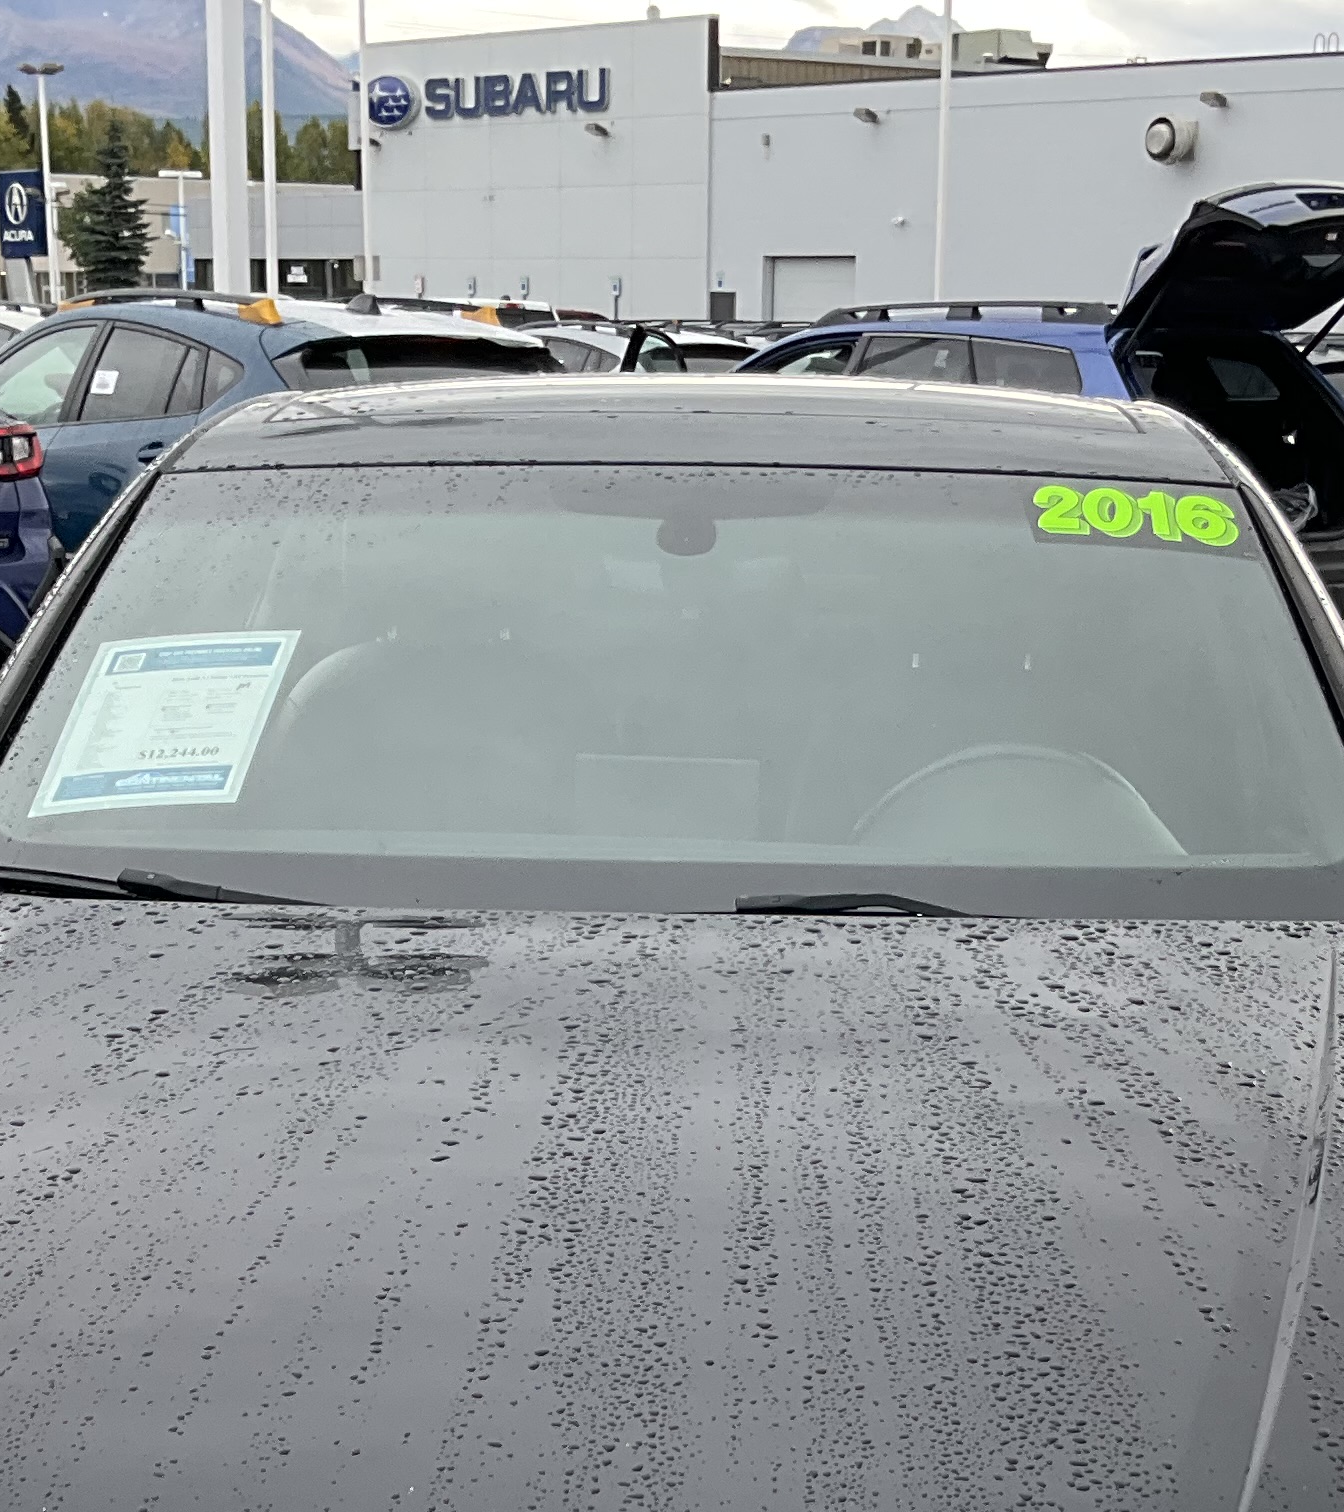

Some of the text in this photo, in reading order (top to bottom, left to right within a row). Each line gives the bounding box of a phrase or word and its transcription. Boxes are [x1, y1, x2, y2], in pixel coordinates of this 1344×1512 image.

[424, 67, 610, 120] SUBARU
[2, 229, 35, 242] ACURA
[1032, 484, 1240, 547] 2016
